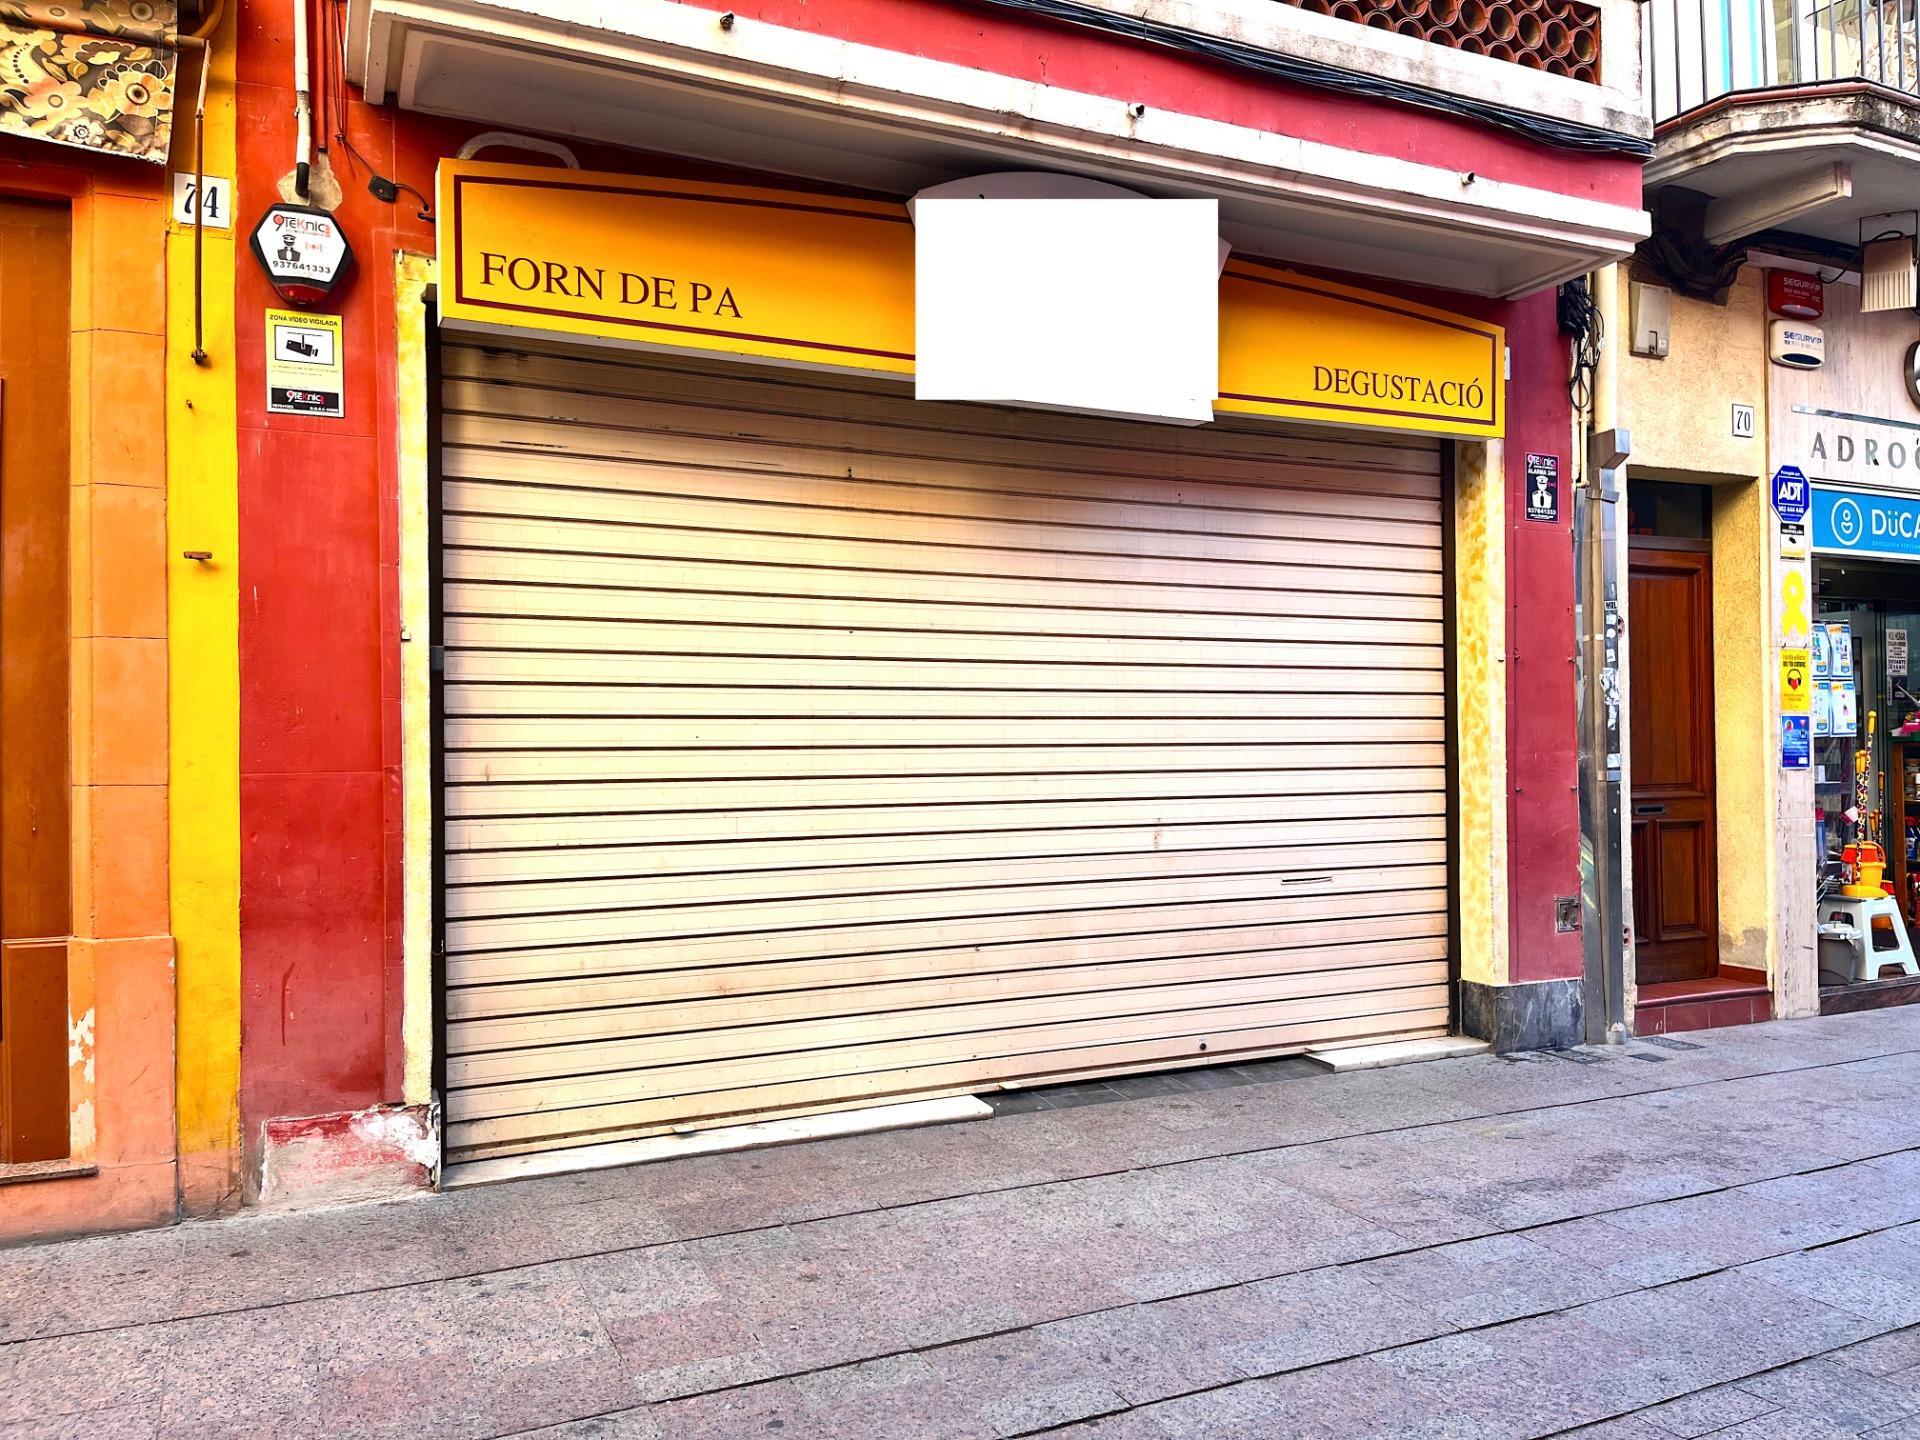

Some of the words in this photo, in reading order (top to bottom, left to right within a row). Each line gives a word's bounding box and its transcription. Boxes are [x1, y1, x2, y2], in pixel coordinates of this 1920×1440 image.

[184, 182, 220, 219] 74
[272, 260, 331, 274] 937641333
[479, 251, 606, 301] FORN
[618, 271, 678, 310] DE
[689, 281, 744, 319] PA
[269, 314, 288, 322] ZONA
[309, 318, 338, 327] VIGILADA
[1312, 365, 1484, 409] DEGUSTACIÓ
[1737, 410, 1751, 431] 70
[1778, 481, 1803, 501] ADT
